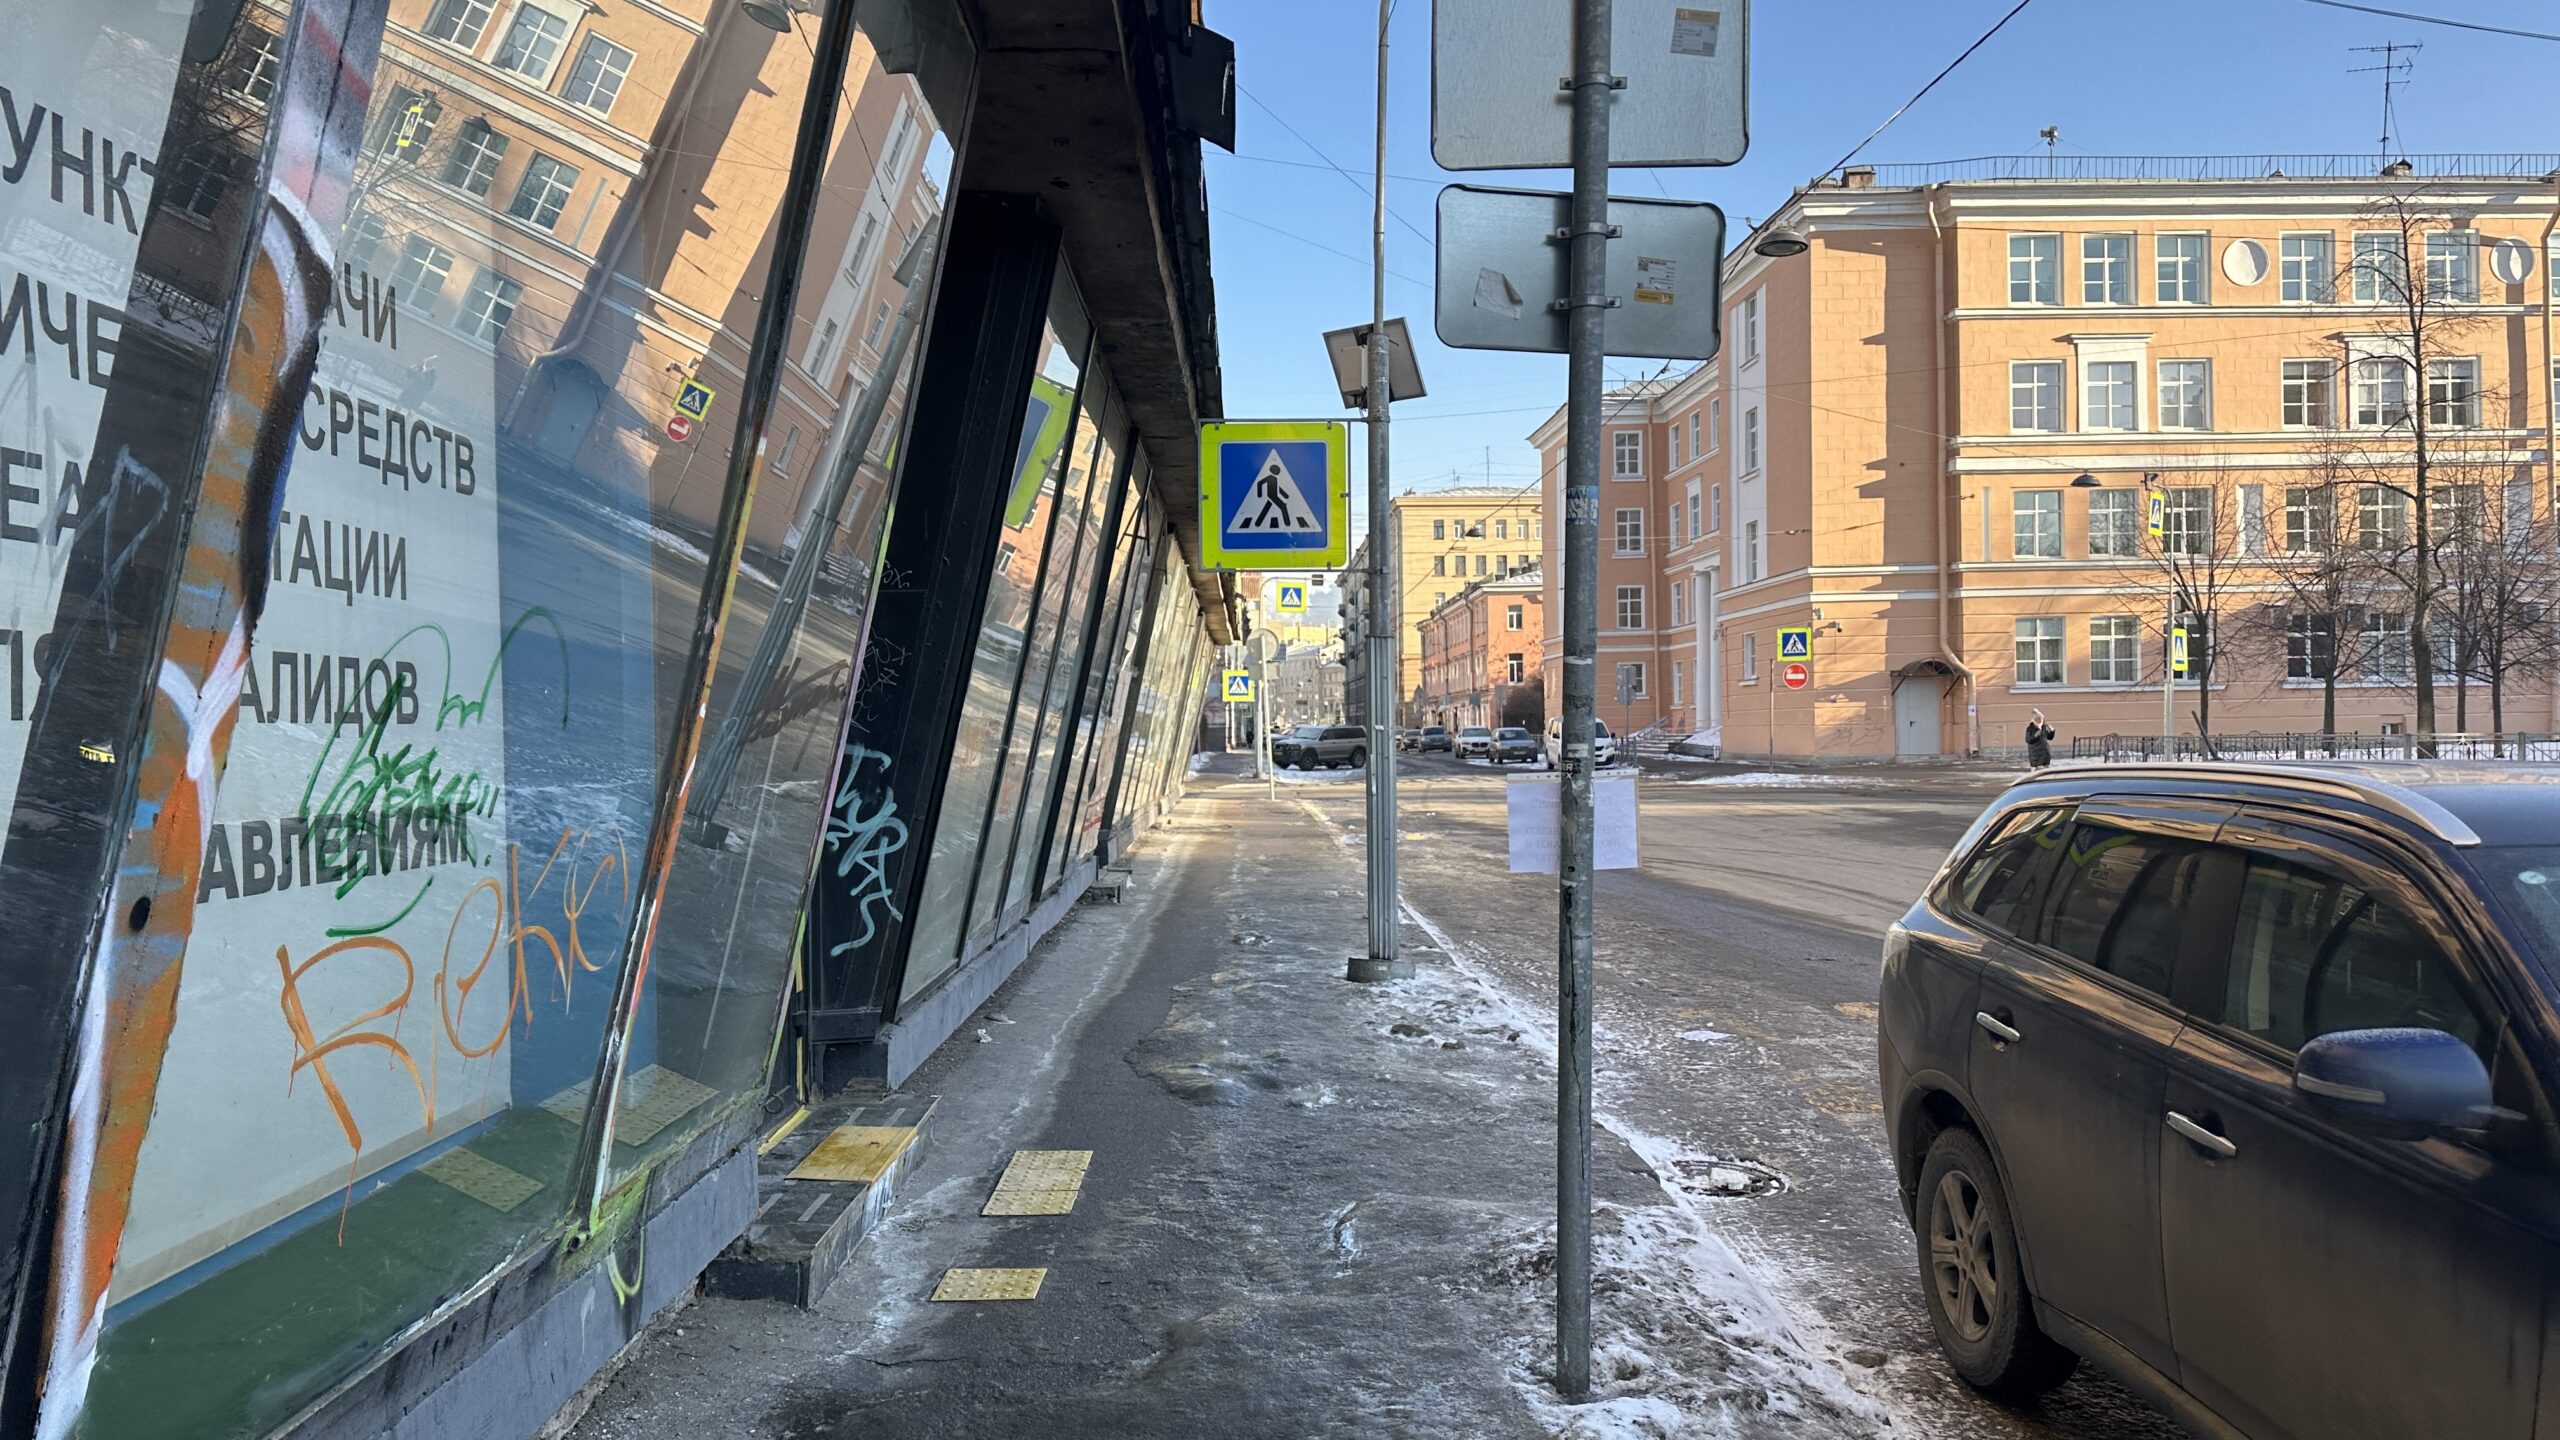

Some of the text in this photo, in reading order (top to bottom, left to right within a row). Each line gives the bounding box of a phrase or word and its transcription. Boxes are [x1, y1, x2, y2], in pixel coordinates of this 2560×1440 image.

[299, 381, 476, 496] СРЕДСТВ
[272, 510, 408, 607] ТАЦИИ
[236, 650, 419, 739] АЛИДОВ
